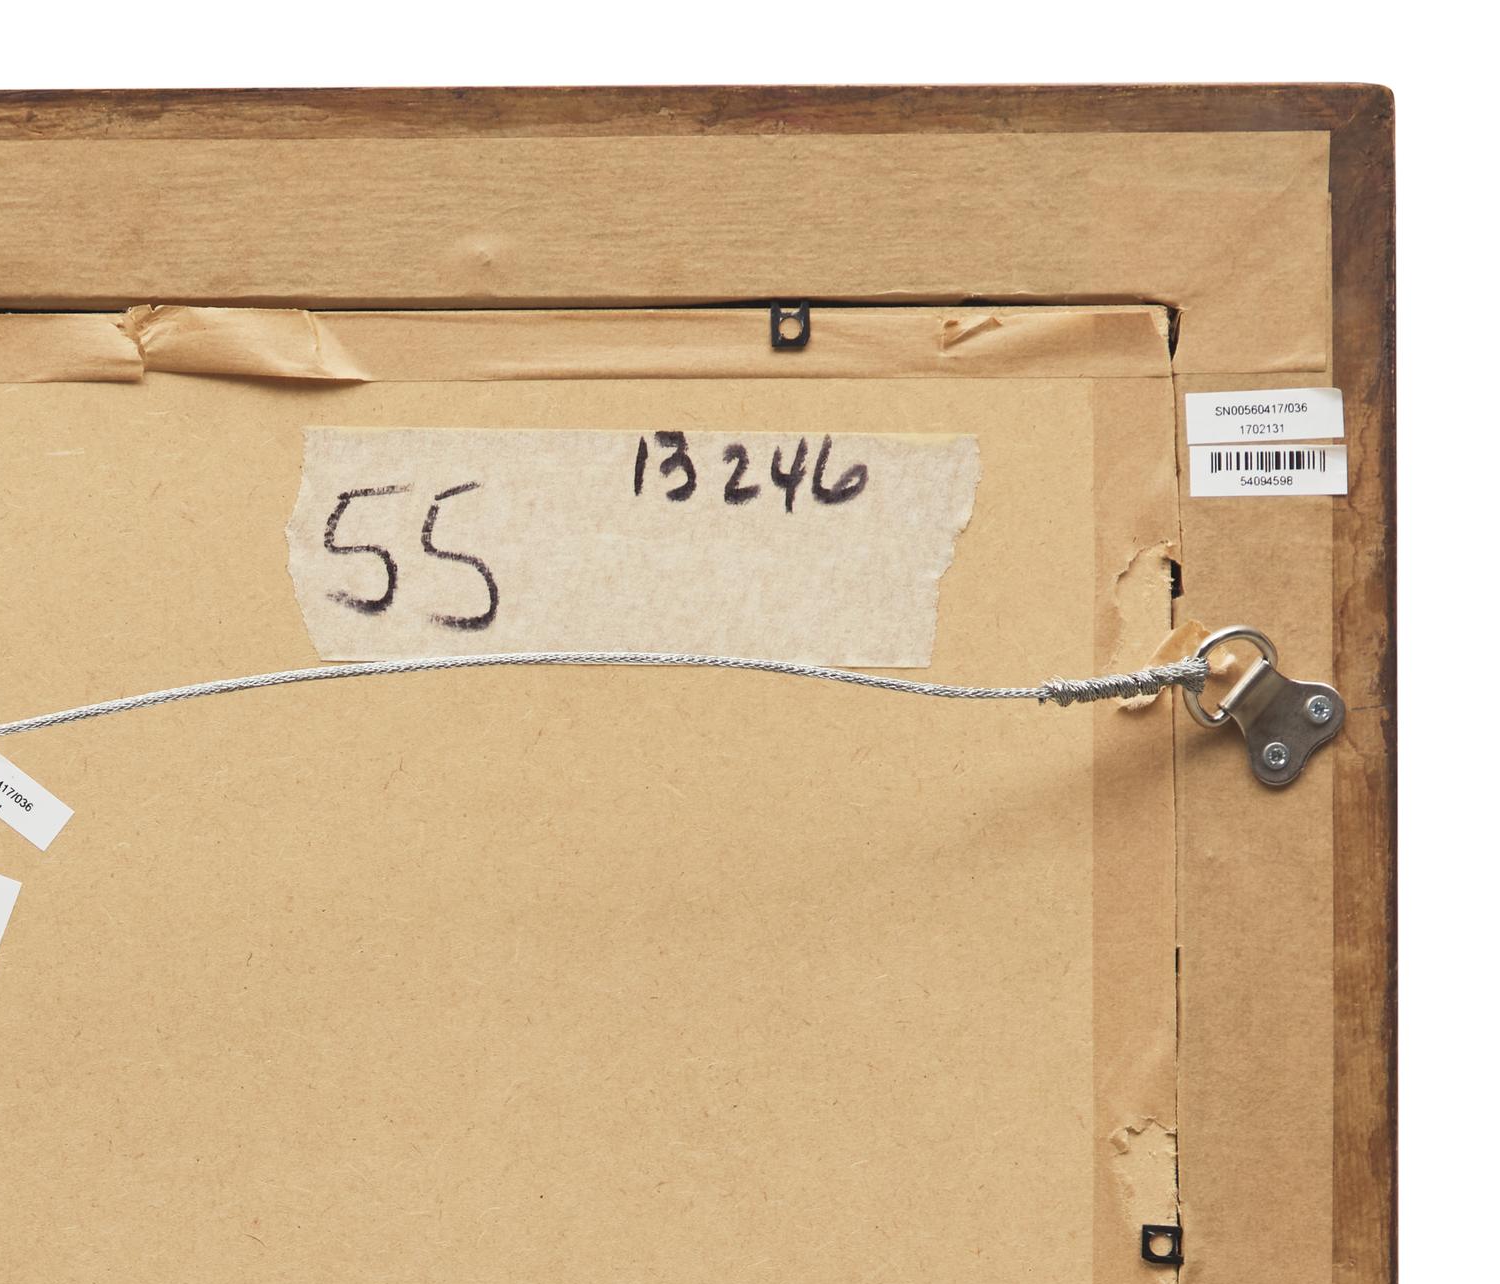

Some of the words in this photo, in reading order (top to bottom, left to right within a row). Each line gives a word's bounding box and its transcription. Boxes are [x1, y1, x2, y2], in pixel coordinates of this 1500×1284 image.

[1215, 402, 1308, 416] SN00560417/036
[1240, 423, 1284, 435] 1702131
[1240, 475, 1293, 486] 54094598
[323, 481, 499, 631] 55
